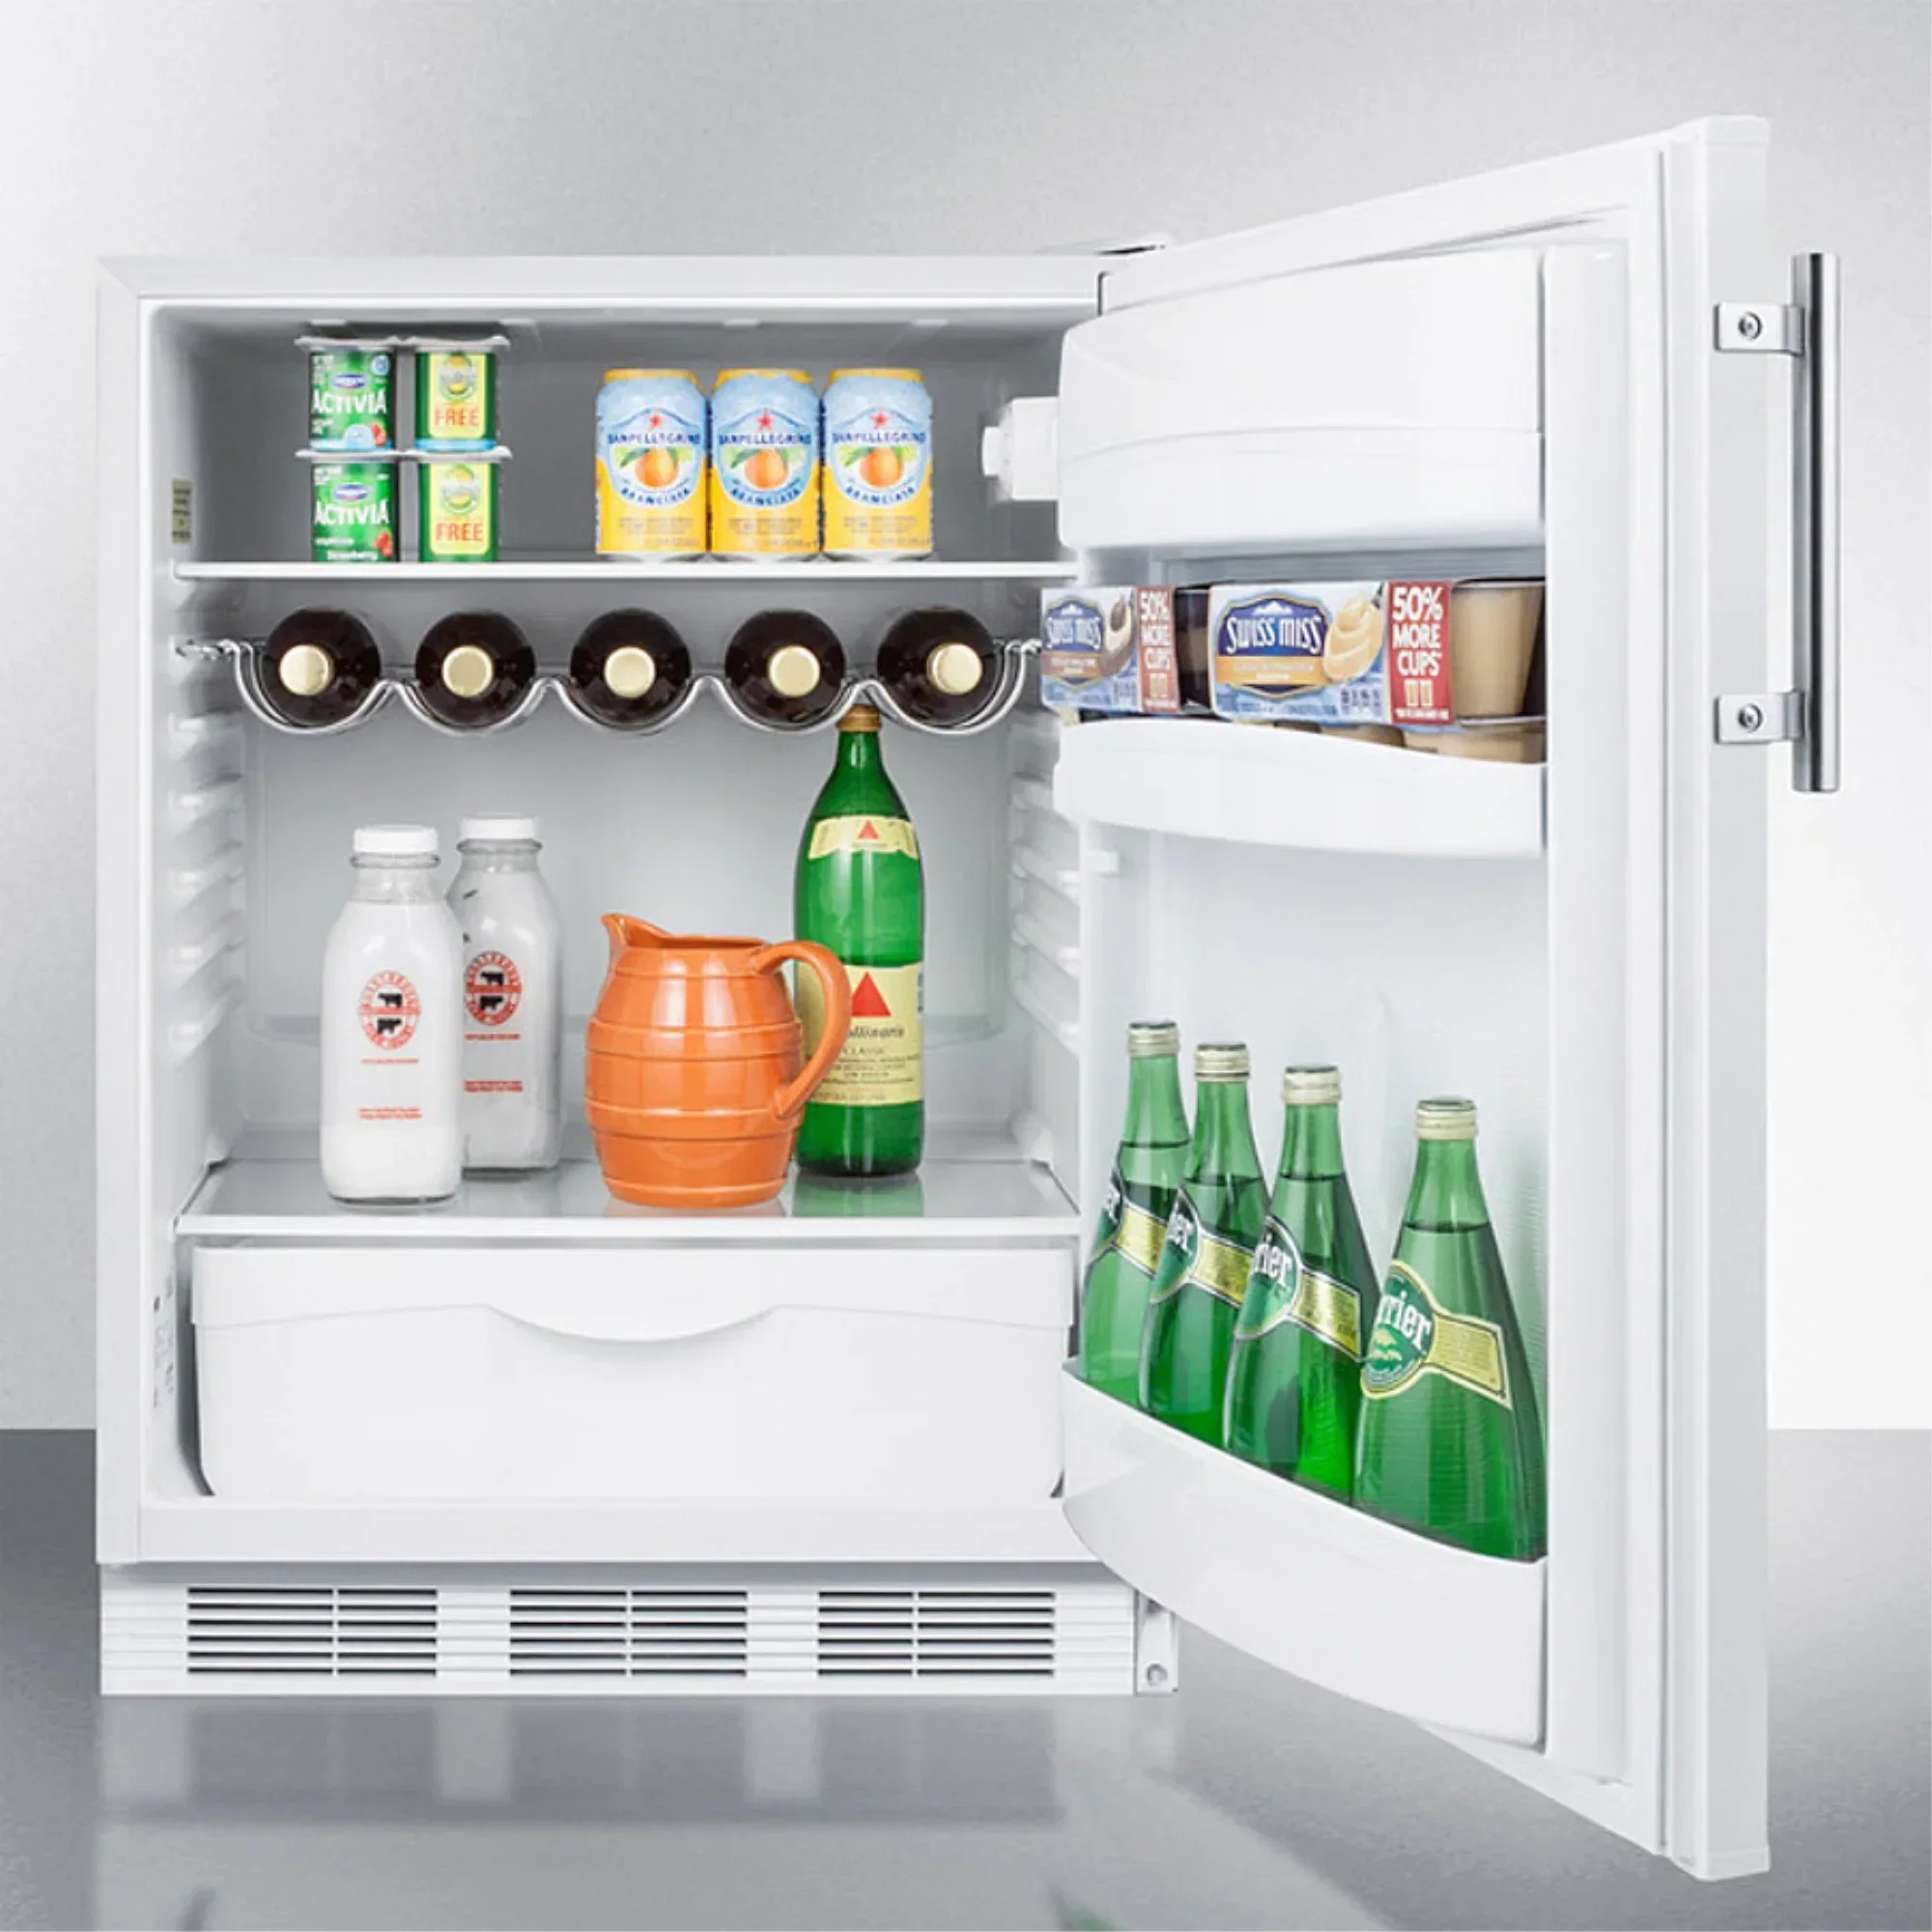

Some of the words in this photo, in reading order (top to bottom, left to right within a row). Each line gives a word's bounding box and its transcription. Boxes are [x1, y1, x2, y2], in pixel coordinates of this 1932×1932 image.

[310, 387, 386, 414] ACTIVIA
[435, 409, 480, 426] FREE
[313, 498, 389, 525] ACTIVIA
[436, 523, 483, 541] FREE
[1392, 585, 1445, 622] 50%
[1226, 615, 1275, 655] SWISS
[1392, 623, 1442, 649] MORE
[1397, 649, 1442, 676] CUPS
